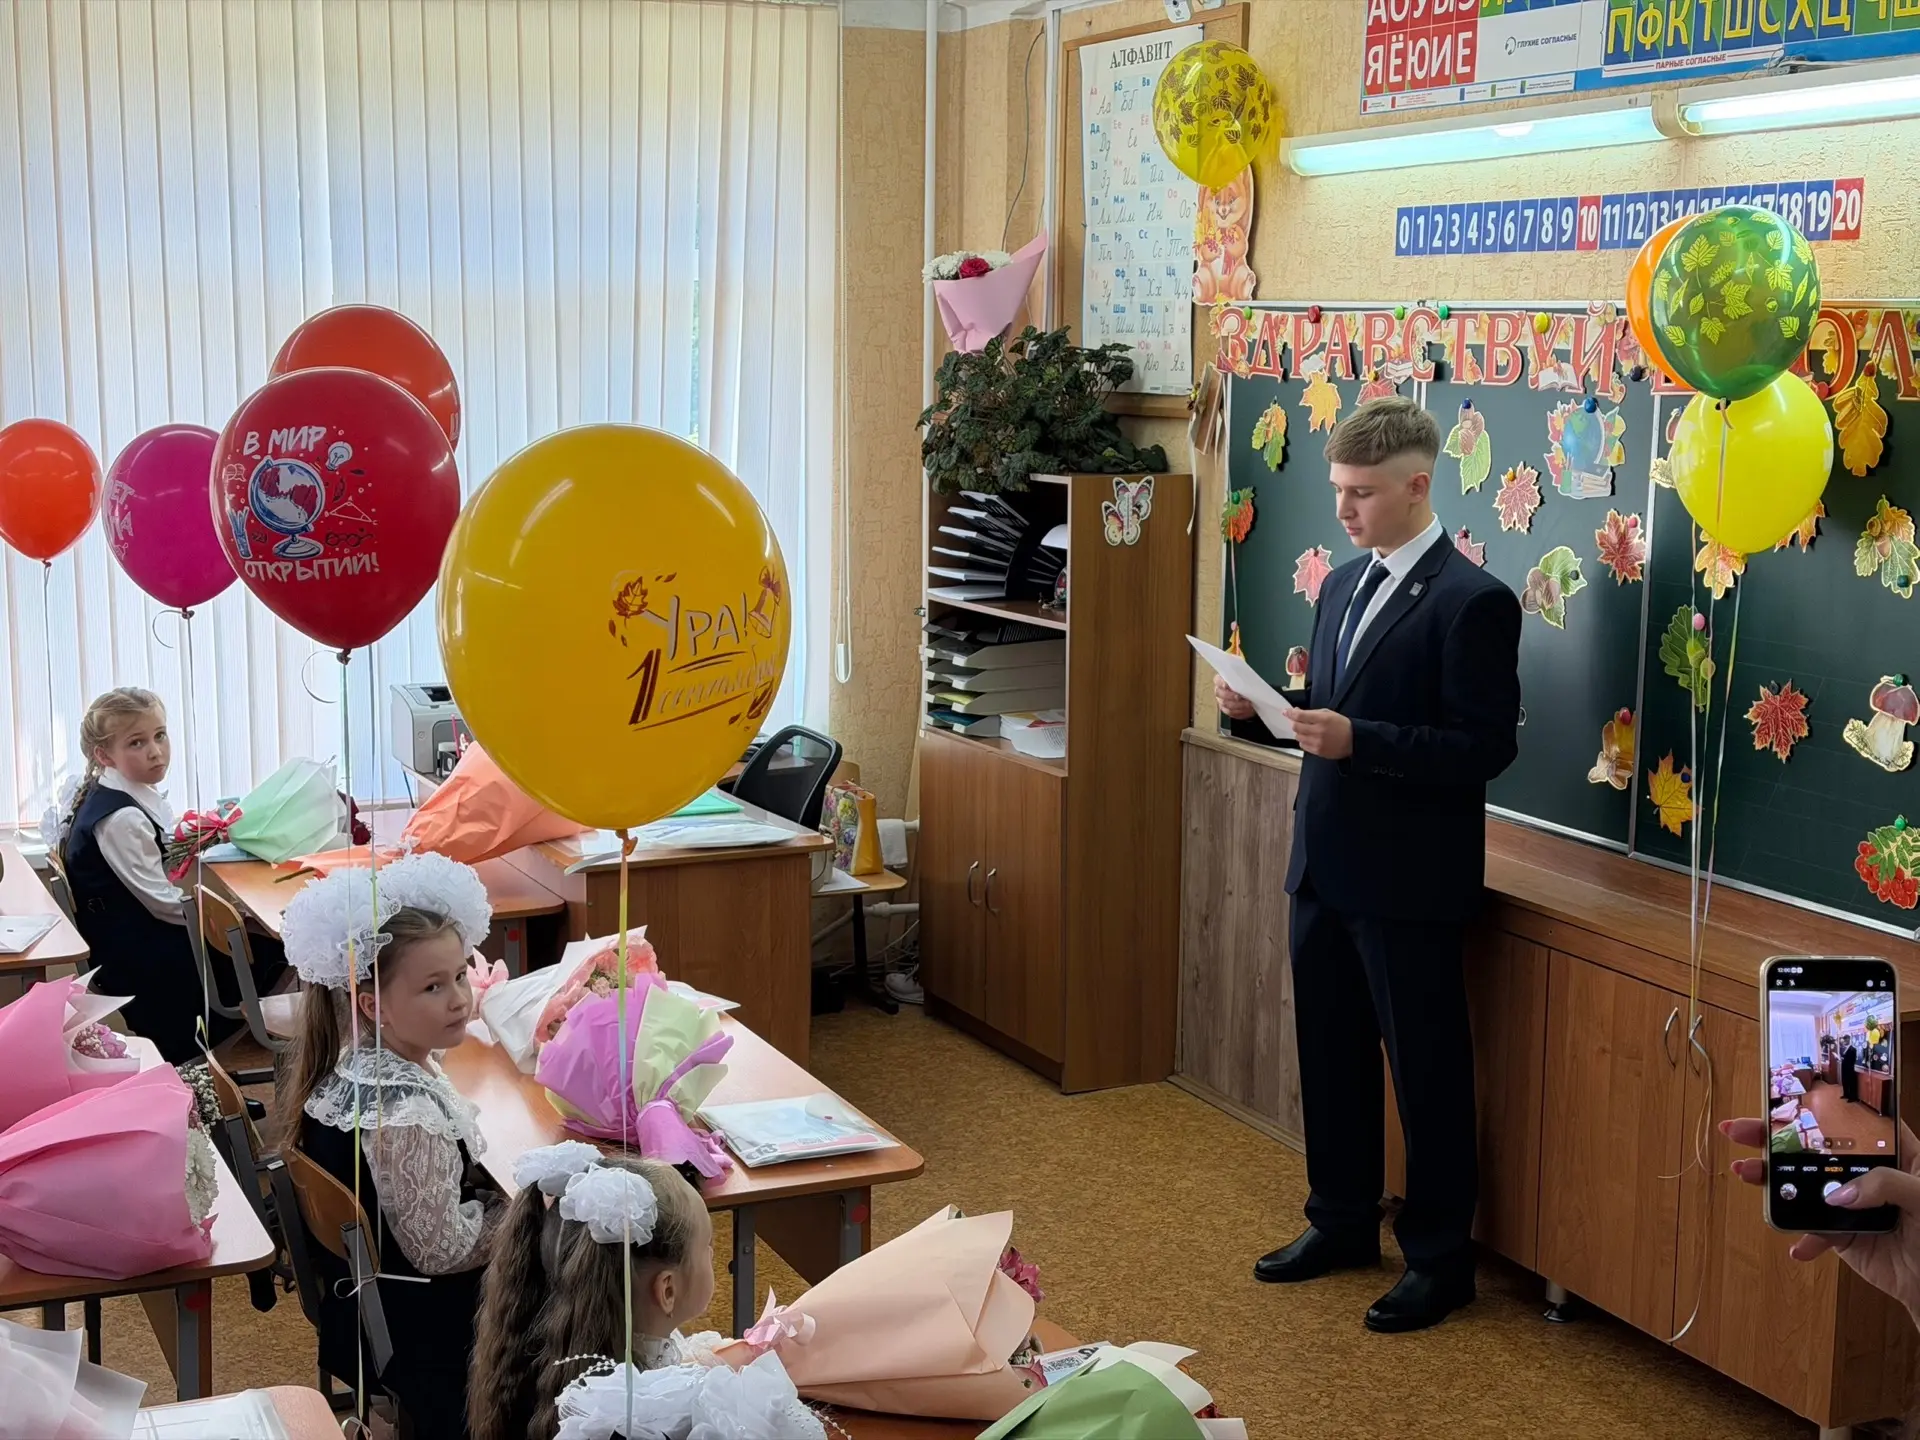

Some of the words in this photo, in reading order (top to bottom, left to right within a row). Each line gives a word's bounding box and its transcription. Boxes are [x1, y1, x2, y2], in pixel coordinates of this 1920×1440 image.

[1110, 41, 1173, 69] АЛФАВИТ
[1517, 38, 1540, 48] ГЛУХИЕ
[1541, 33, 1577, 45] СОГЛАСНЫЕ
[1655, 60, 1684, 69] ПАРНЫЕ
[1686, 54, 1727, 66] СОГЛАСНЫЕ
[1416, 214, 1425, 248] 1
[1432, 213, 1444, 247] 2
[1450, 212, 1460, 247] 3
[1467, 211, 1479, 246] 4
[1485, 210, 1497, 245] 5
[1503, 209, 1516, 245] 6
[1523, 208, 1535, 244] 7
[1541, 207, 1553, 244] 8
[1561, 206, 1574, 243] 9
[1580, 205, 1598, 242] 10
[1603, 204, 1621, 241] 11
[1625, 202, 1646, 240] 12
[1807, 190, 1832, 232] 19
[1834, 189, 1861, 231] 20
[243, 431, 260, 456] В
[268, 425, 327, 454] МИР
[244, 552, 381, 582] ОТКРЫТИЙ!
[639, 592, 748, 661] УРА!
[627, 648, 661, 725] 1
